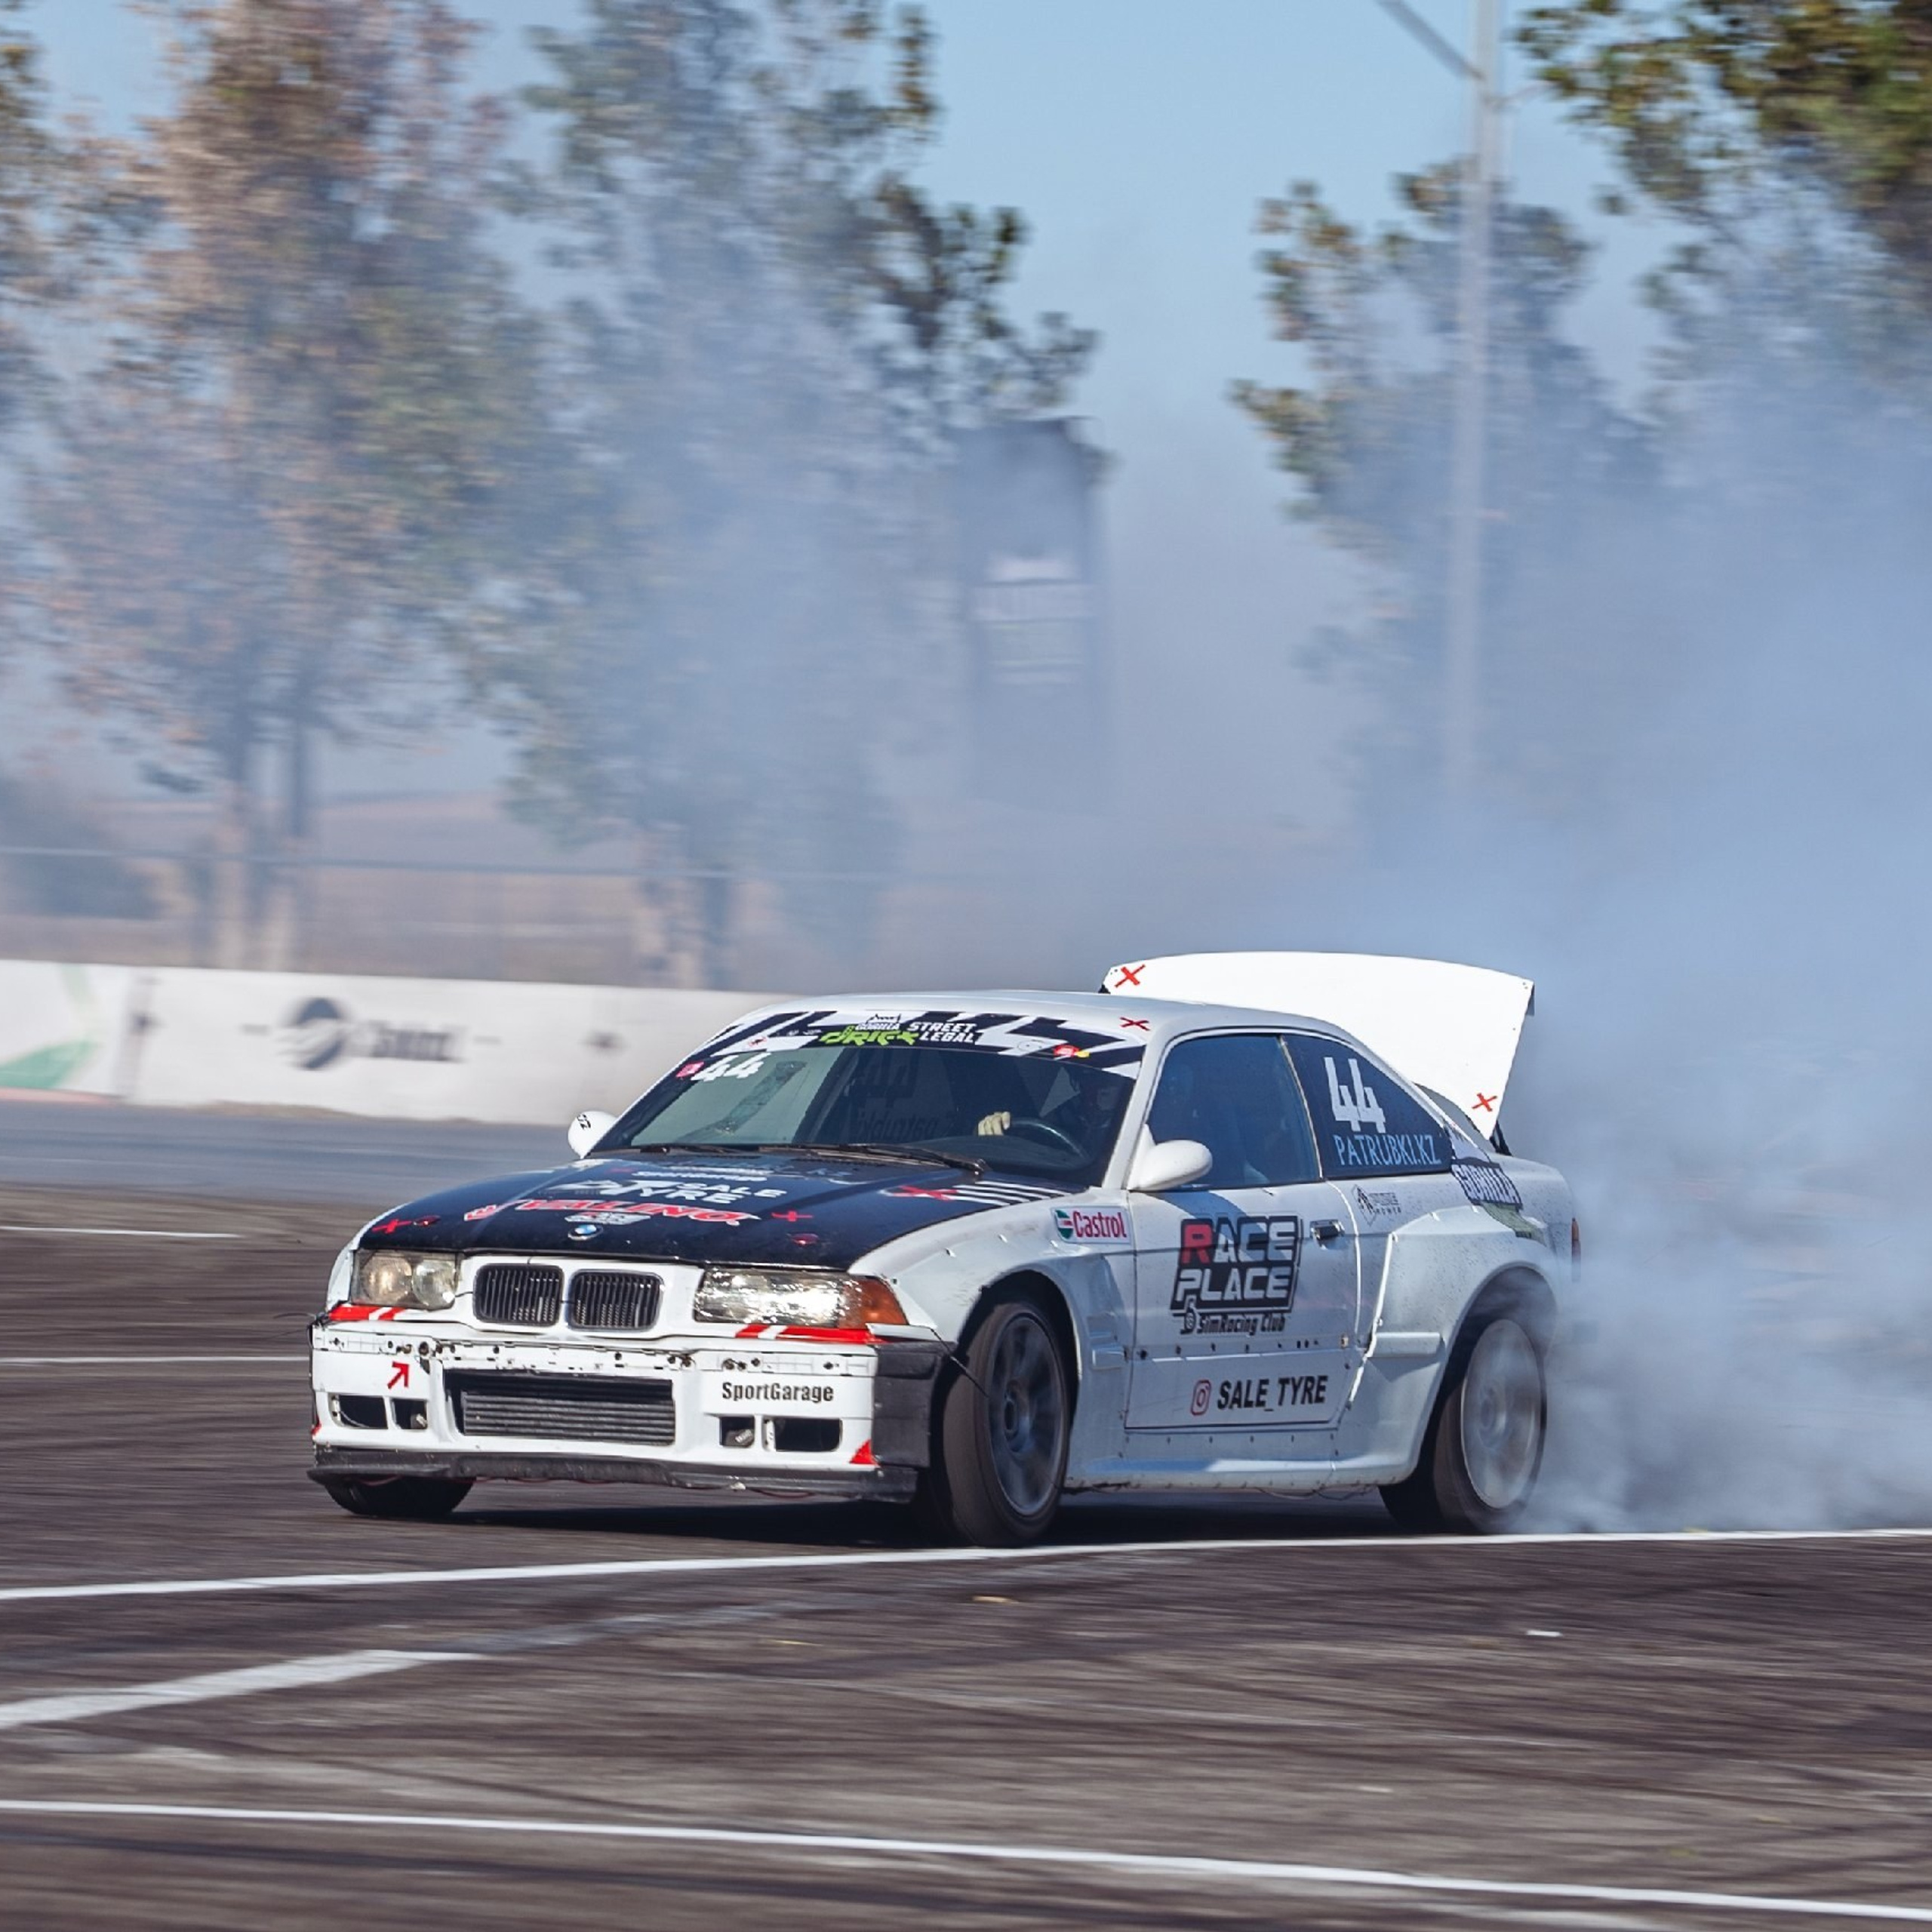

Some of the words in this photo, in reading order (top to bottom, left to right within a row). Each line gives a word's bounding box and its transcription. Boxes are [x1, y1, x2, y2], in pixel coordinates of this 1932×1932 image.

[906, 1021, 977, 1033] STREET
[919, 1032, 975, 1044] LEGAL
[691, 1053, 771, 1081] 44
[1324, 1057, 1386, 1134] 44
[1333, 1134, 1442, 1166] PATRUBKI.KZ
[676, 1183, 787, 1198] SALE
[1072, 1211, 1128, 1238] Castrol
[1180, 1219, 1297, 1265] RACE
[1175, 1266, 1292, 1303] PLACE
[1261, 1313, 1286, 1333] Club
[721, 1381, 835, 1404] SportGarage
